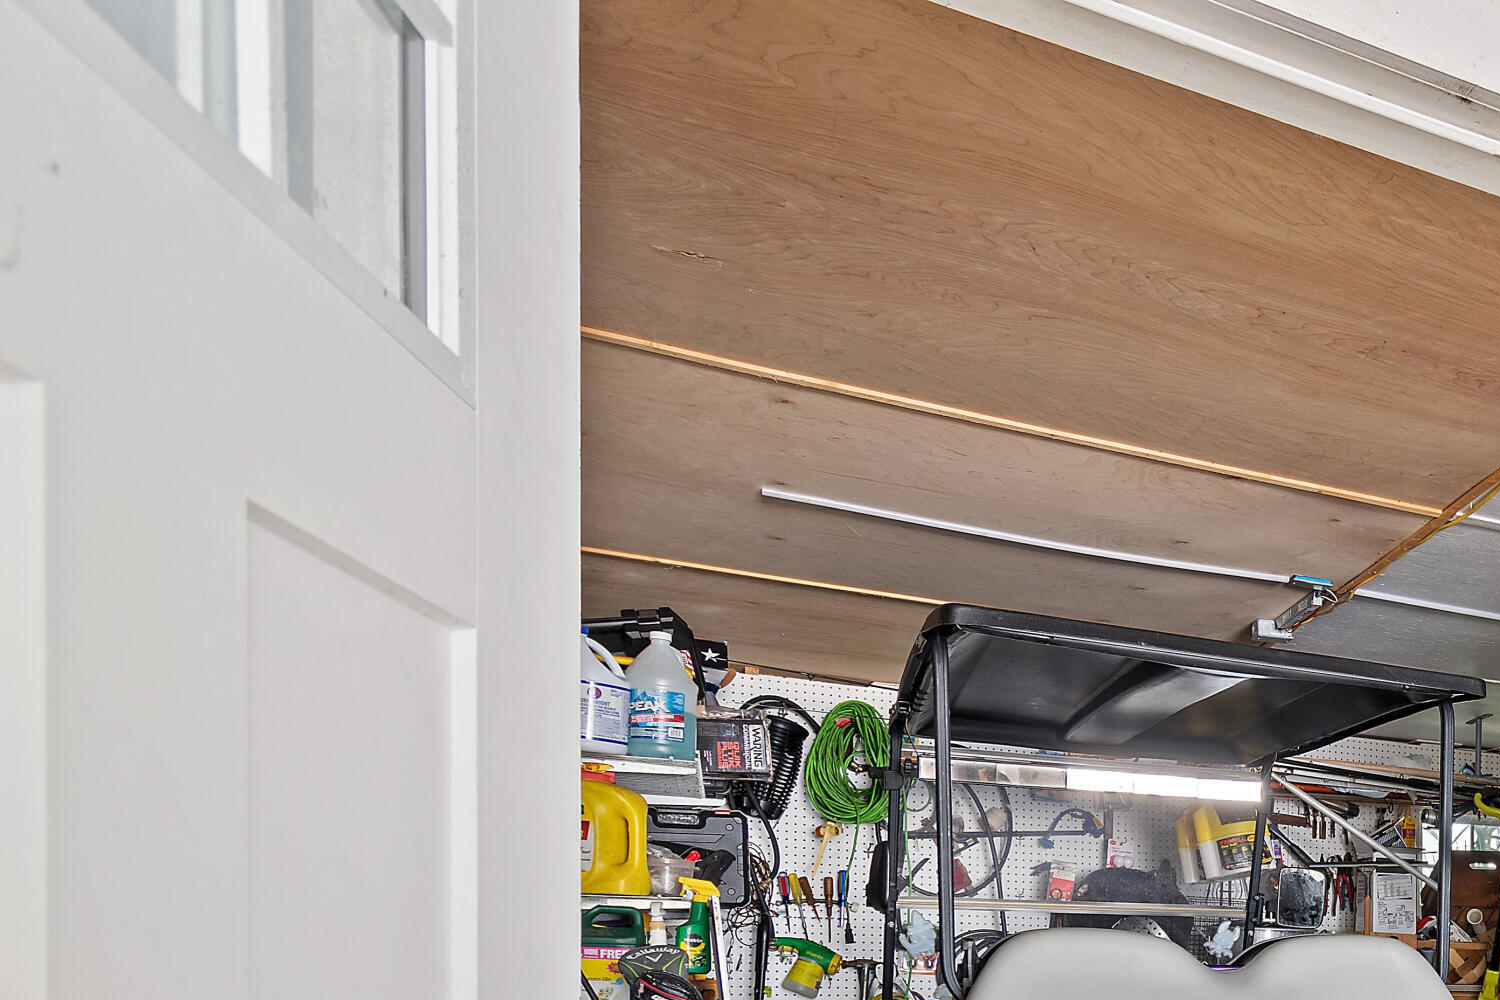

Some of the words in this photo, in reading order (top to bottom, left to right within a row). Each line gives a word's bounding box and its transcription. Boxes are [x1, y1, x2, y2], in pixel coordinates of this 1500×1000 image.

[629, 700, 671, 713] PEAK
[742, 724, 751, 770] COMMERCIAL
[750, 727, 763, 768] WARING
[626, 947, 681, 960] Callaway
